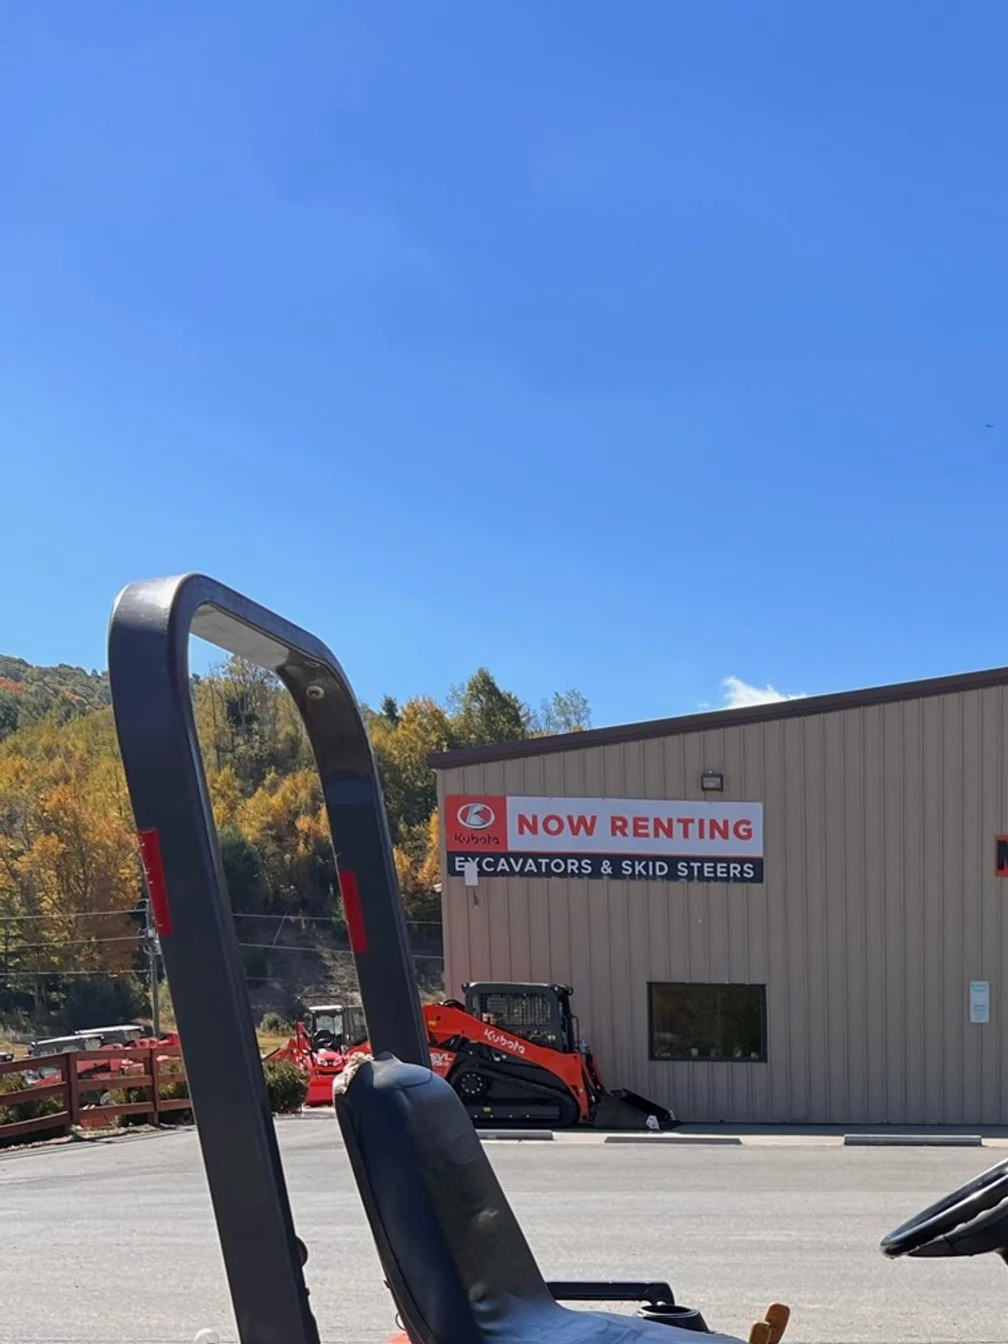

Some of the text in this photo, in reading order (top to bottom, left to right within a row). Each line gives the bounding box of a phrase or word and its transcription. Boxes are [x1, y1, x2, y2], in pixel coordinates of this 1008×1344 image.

[517, 813, 754, 841] NOW RENTING
[454, 833, 500, 845] Kubota
[600, 860, 613, 875] &
[621, 861, 668, 876] SKID
[676, 862, 756, 878] STEERS
[484, 1028, 525, 1054] Kubota
